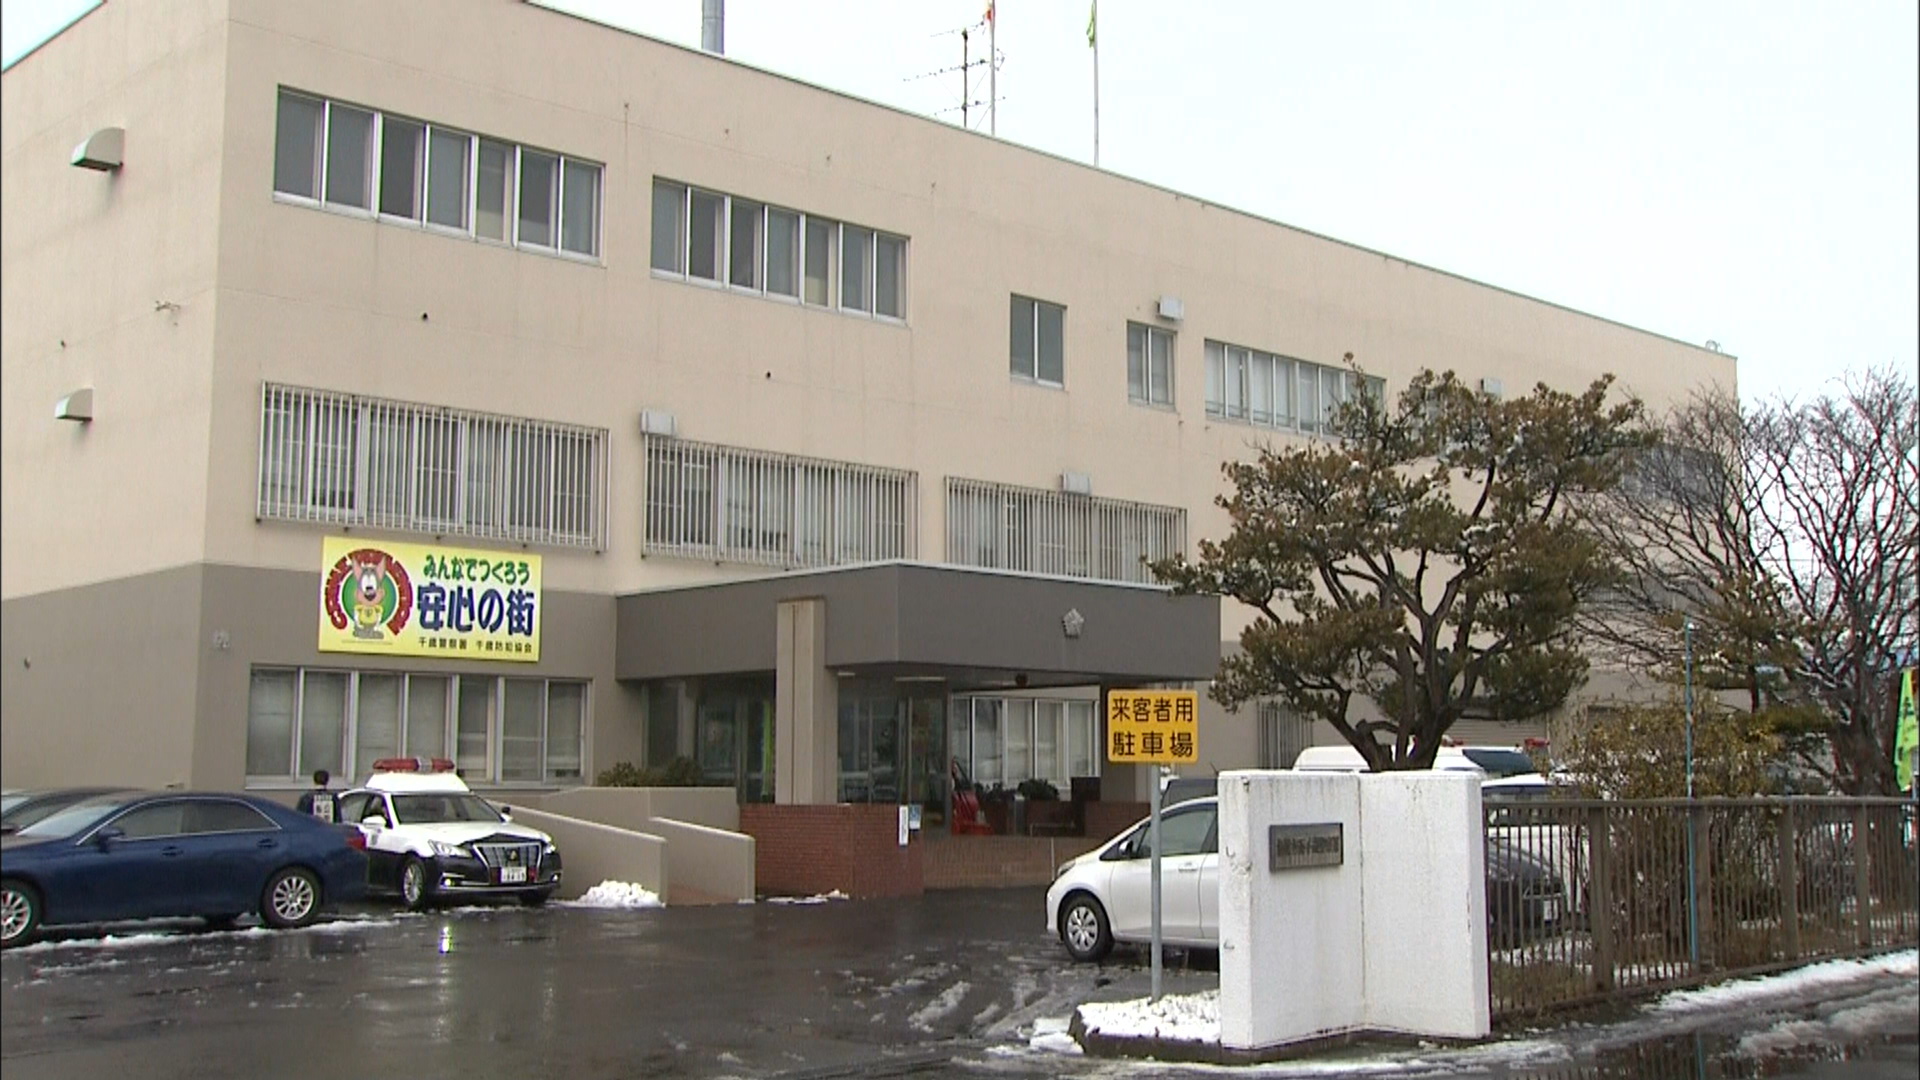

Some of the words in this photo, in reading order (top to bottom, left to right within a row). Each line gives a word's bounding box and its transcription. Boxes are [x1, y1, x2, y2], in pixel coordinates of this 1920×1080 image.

[417, 582, 535, 637] 安心の街
[1112, 697, 1193, 722] 来客者用
[1112, 731, 1194, 757] 駐車場
